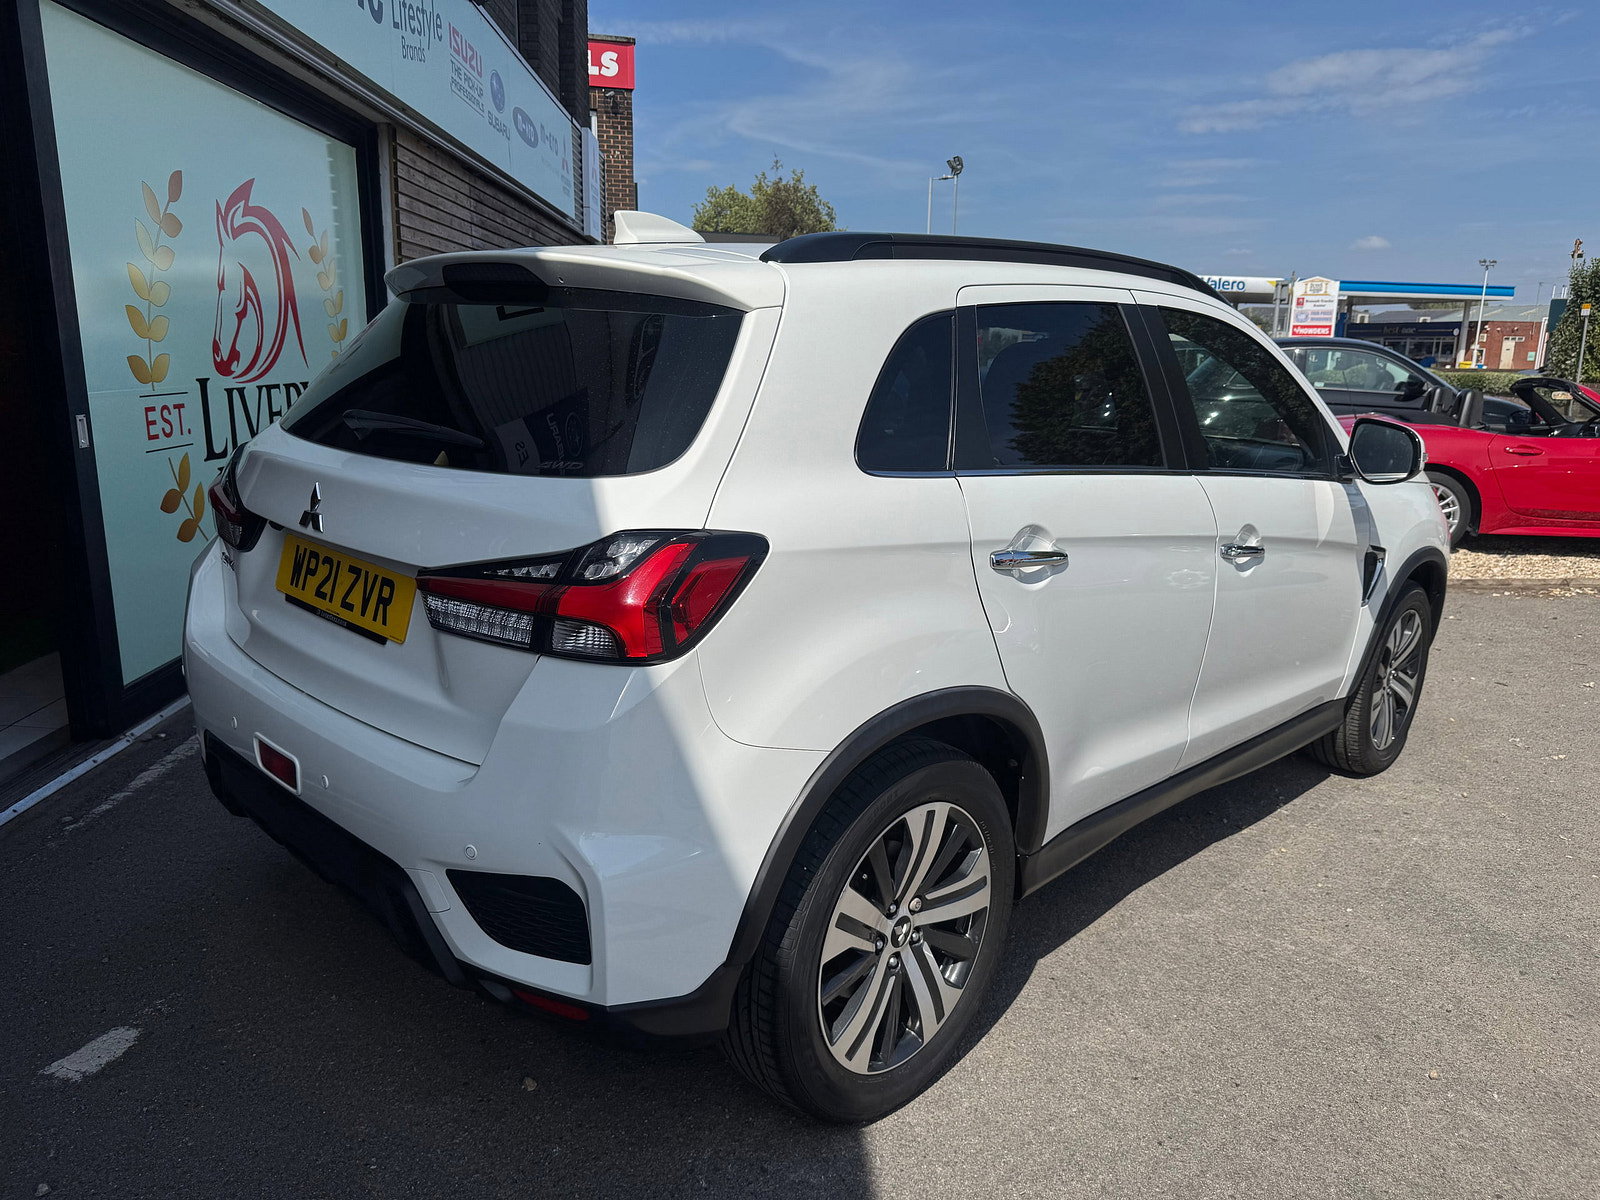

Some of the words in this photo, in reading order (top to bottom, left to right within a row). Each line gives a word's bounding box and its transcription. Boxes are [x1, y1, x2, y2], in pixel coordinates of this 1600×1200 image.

[391, 0, 443, 50] Lifestyle
[401, 35, 426, 63] Brands
[448, 21, 483, 78] ISUZU
[450, 59, 463, 81] THE
[487, 110, 511, 141] SUBARU
[144, 403, 192, 441] EST.
[290, 545, 341, 603] WP21
[340, 564, 396, 626] ZVR
